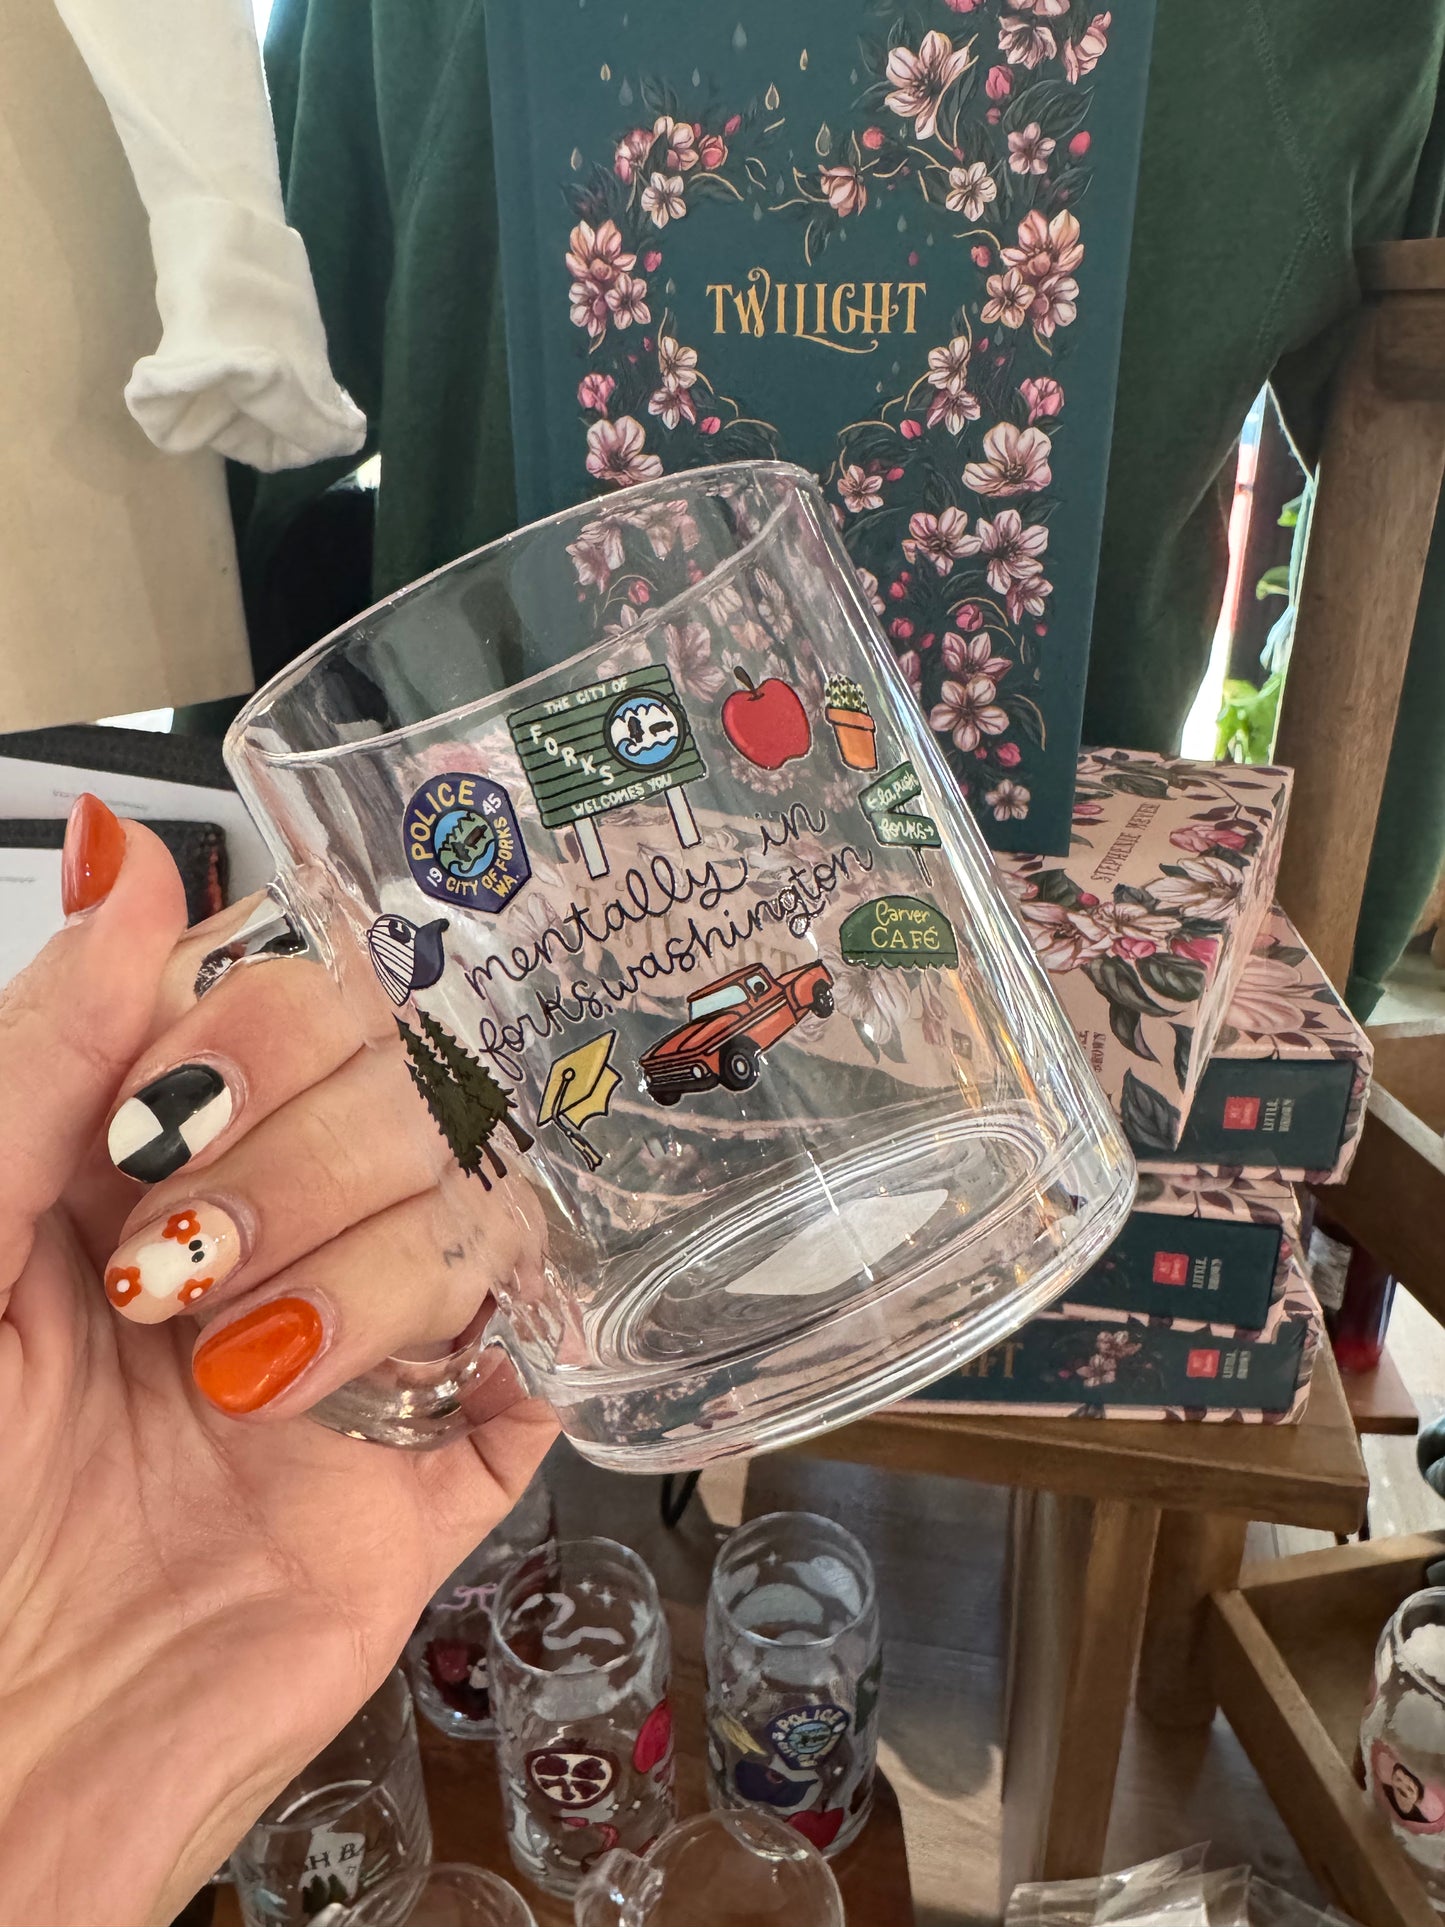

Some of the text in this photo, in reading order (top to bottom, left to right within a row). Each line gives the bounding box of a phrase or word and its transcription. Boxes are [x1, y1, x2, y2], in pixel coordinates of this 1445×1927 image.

[706, 266, 927, 354] TWILIGHT
[544, 677, 630, 715] THE CITY OF
[529, 724, 616, 786] FORKS
[410, 780, 476, 861] POLICE
[482, 793, 502, 815] 45
[571, 773, 674, 816] WELCOMES YOU
[446, 816, 514, 896] CITY OF FORKS
[1090, 832, 1142, 883] STEPHENIE
[464, 801, 827, 1000] mentally in
[875, 900, 931, 926] Carver
